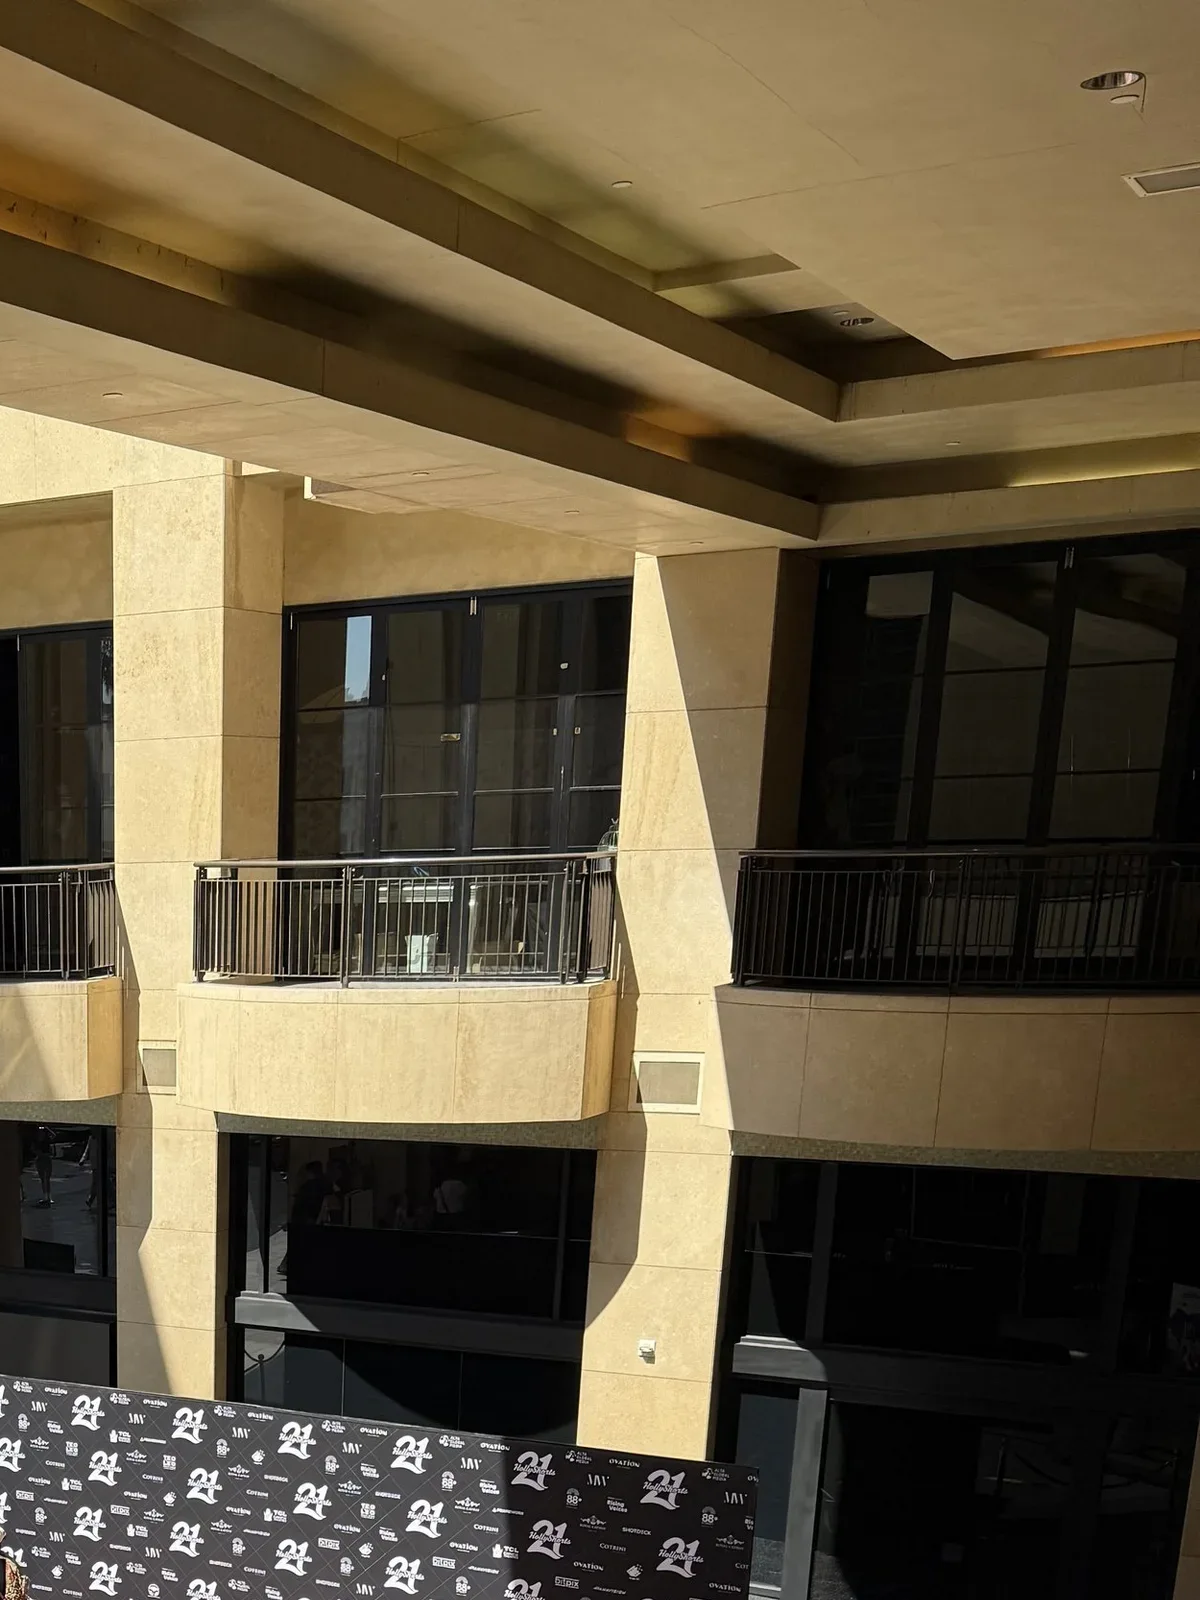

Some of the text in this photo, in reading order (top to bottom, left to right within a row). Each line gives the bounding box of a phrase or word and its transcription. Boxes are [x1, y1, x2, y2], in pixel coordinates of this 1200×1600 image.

[71, 1395, 101, 1430] 21
[172, 1407, 204, 1444] 21
[278, 1422, 313, 1459] 21
[390, 1435, 429, 1474] 21
[186, 1468, 219, 1504] 21
[511, 1451, 552, 1491] 21
[640, 1469, 685, 1510] 21
[293, 1482, 328, 1520] 21
[405, 1499, 444, 1538] 21
[73, 1506, 102, 1541] 21
[169, 1521, 200, 1557] 21
[527, 1519, 567, 1560] 21
[274, 1539, 308, 1576] 21
[383, 1556, 420, 1594] 21
[656, 1537, 699, 1578] 21
